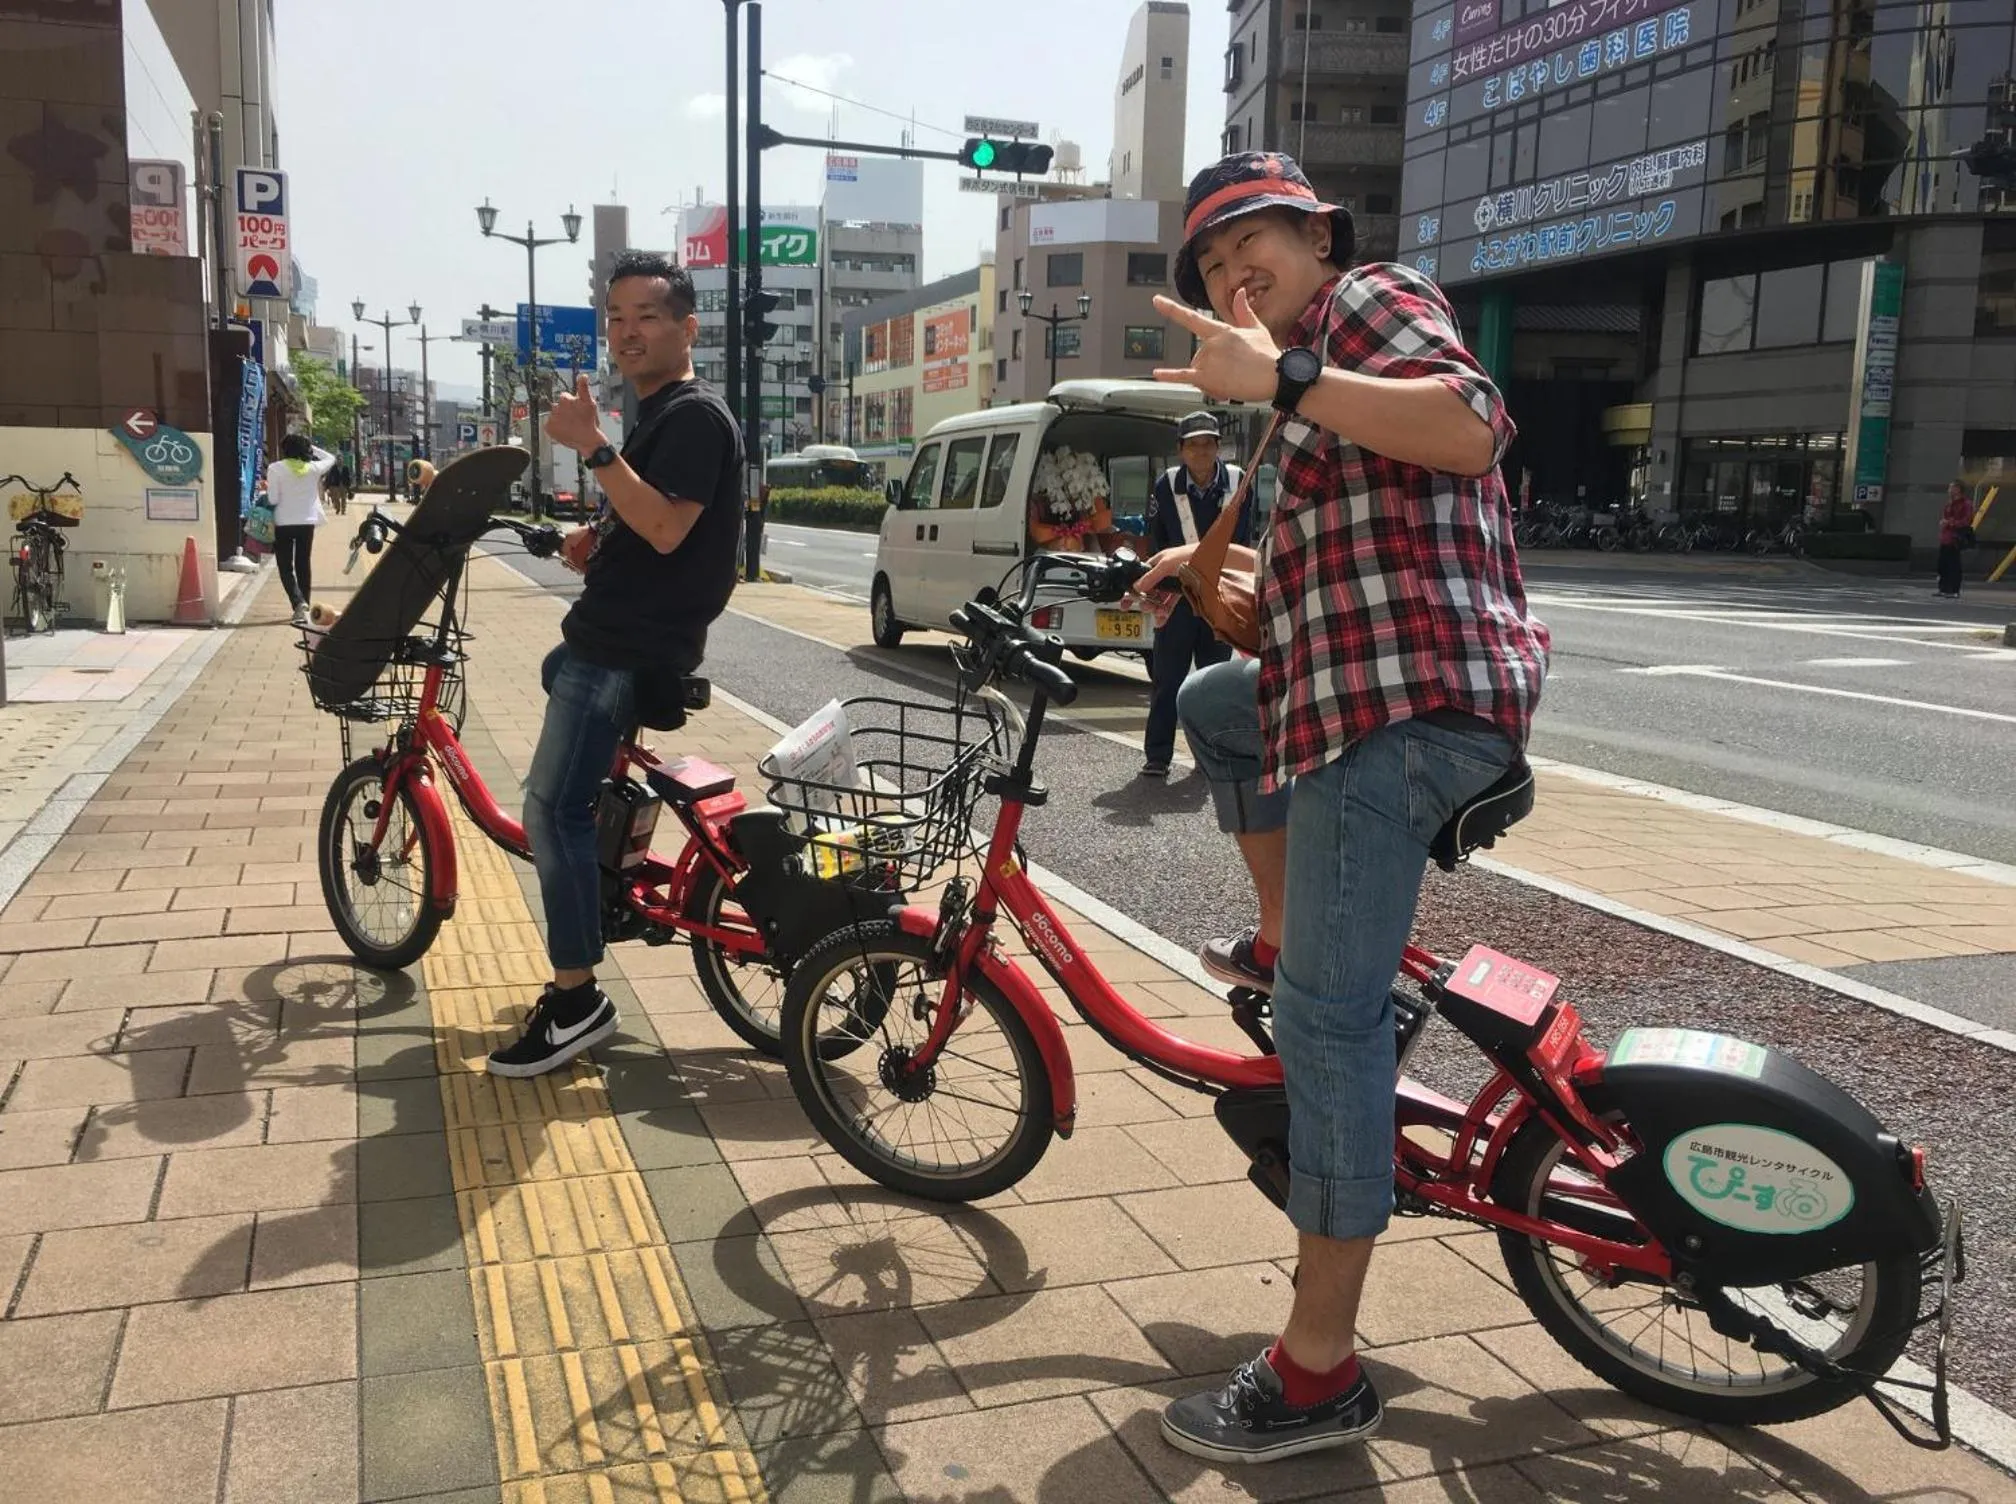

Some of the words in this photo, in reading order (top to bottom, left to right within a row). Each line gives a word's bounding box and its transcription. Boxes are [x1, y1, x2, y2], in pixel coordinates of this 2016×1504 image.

[1452, 0, 1649, 80] 女性だけの30分フィッ
[1483, 7, 1691, 108] こばやし歯科医院
[1424, 99, 1447, 127] 4F
[243, 172, 280, 211] P
[1496, 164, 1629, 226] 横川クリニック
[238, 216, 286, 236] 100円
[239, 234, 286, 249] パーク
[1417, 215, 1439, 244] 3F
[1470, 200, 1676, 273] よこがわ駅前クリニック
[761, 234, 808, 258] イク
[1416, 255, 1436, 278] 2F
[461, 425, 474, 441] P
[1032, 912, 1073, 963] docomo
[1690, 1141, 1834, 1181] 広島市観光レンタサイクル
